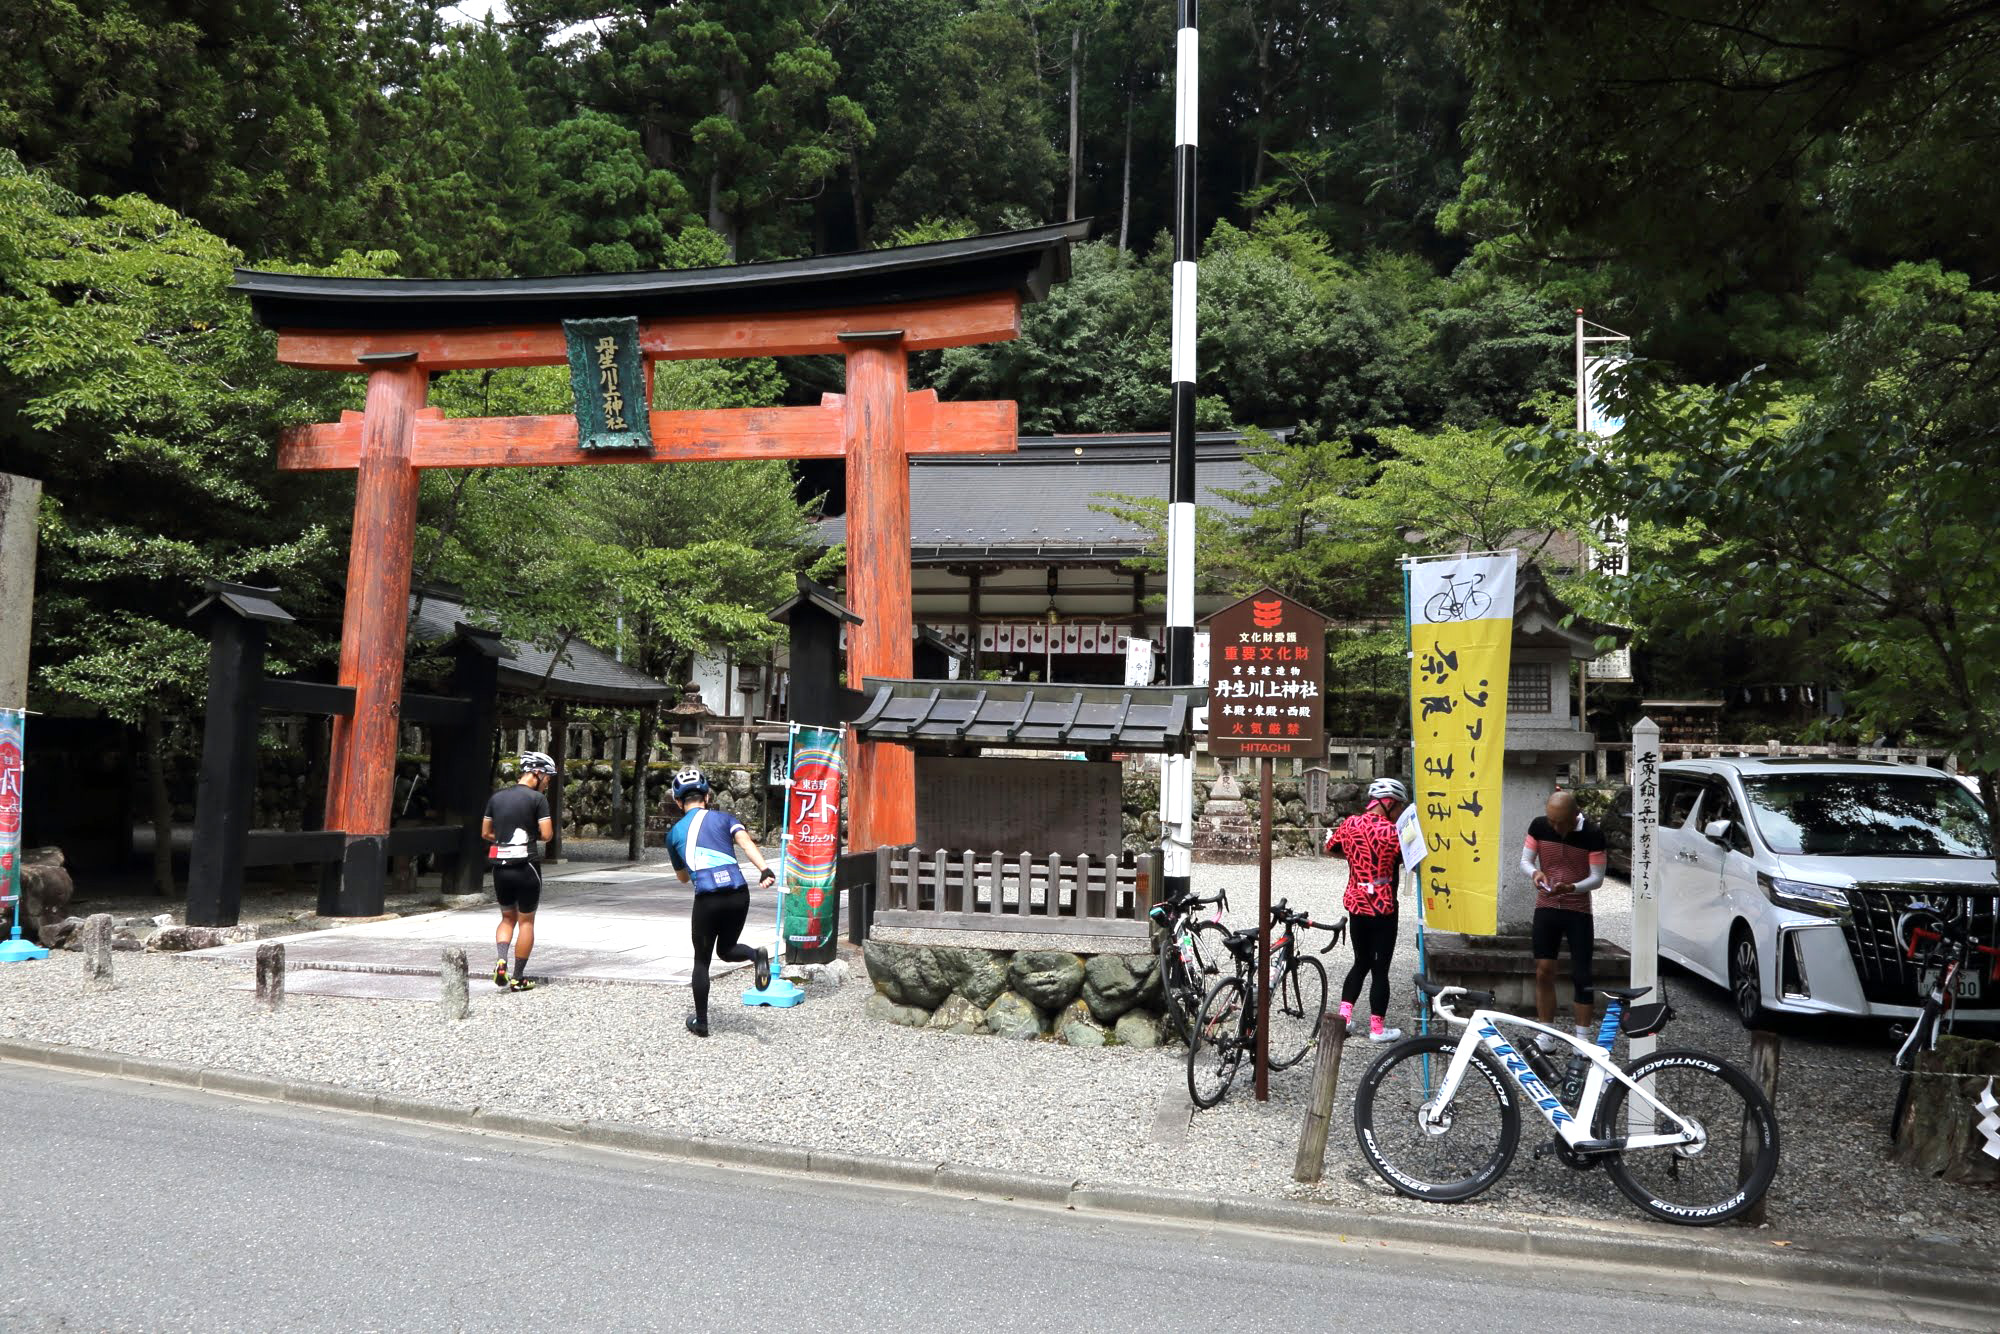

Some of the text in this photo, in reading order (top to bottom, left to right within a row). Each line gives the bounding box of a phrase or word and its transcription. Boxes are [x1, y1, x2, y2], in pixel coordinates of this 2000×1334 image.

[594, 336, 628, 430] 丹生川上神社
[1239, 632, 1297, 643] 文化財愛護
[1224, 646, 1309, 661] 重要文化財
[1232, 665, 1301, 676] 重要建造物
[1214, 679, 1319, 699] 丹生川上神社
[1222, 704, 1311, 717] 本殿・東殿・西殿
[1232, 722, 1301, 735] 火気厳禁
[1240, 743, 1292, 753] HITACHI
[802, 779, 828, 790] 東吉野
[1420, 640, 1458, 910] 奈良・まほろば
[795, 791, 839, 824] アート
[798, 824, 837, 842] プロジェクト
[1637, 751, 1657, 900] 世界人類が平和でありますように
[1439, 1044, 1510, 1106] BONTRAER
[1477, 1020, 1576, 1130] TREK
[1363, 1128, 1431, 1193] BONTRAGER
[1649, 1191, 1746, 1217] BONTRAGER
